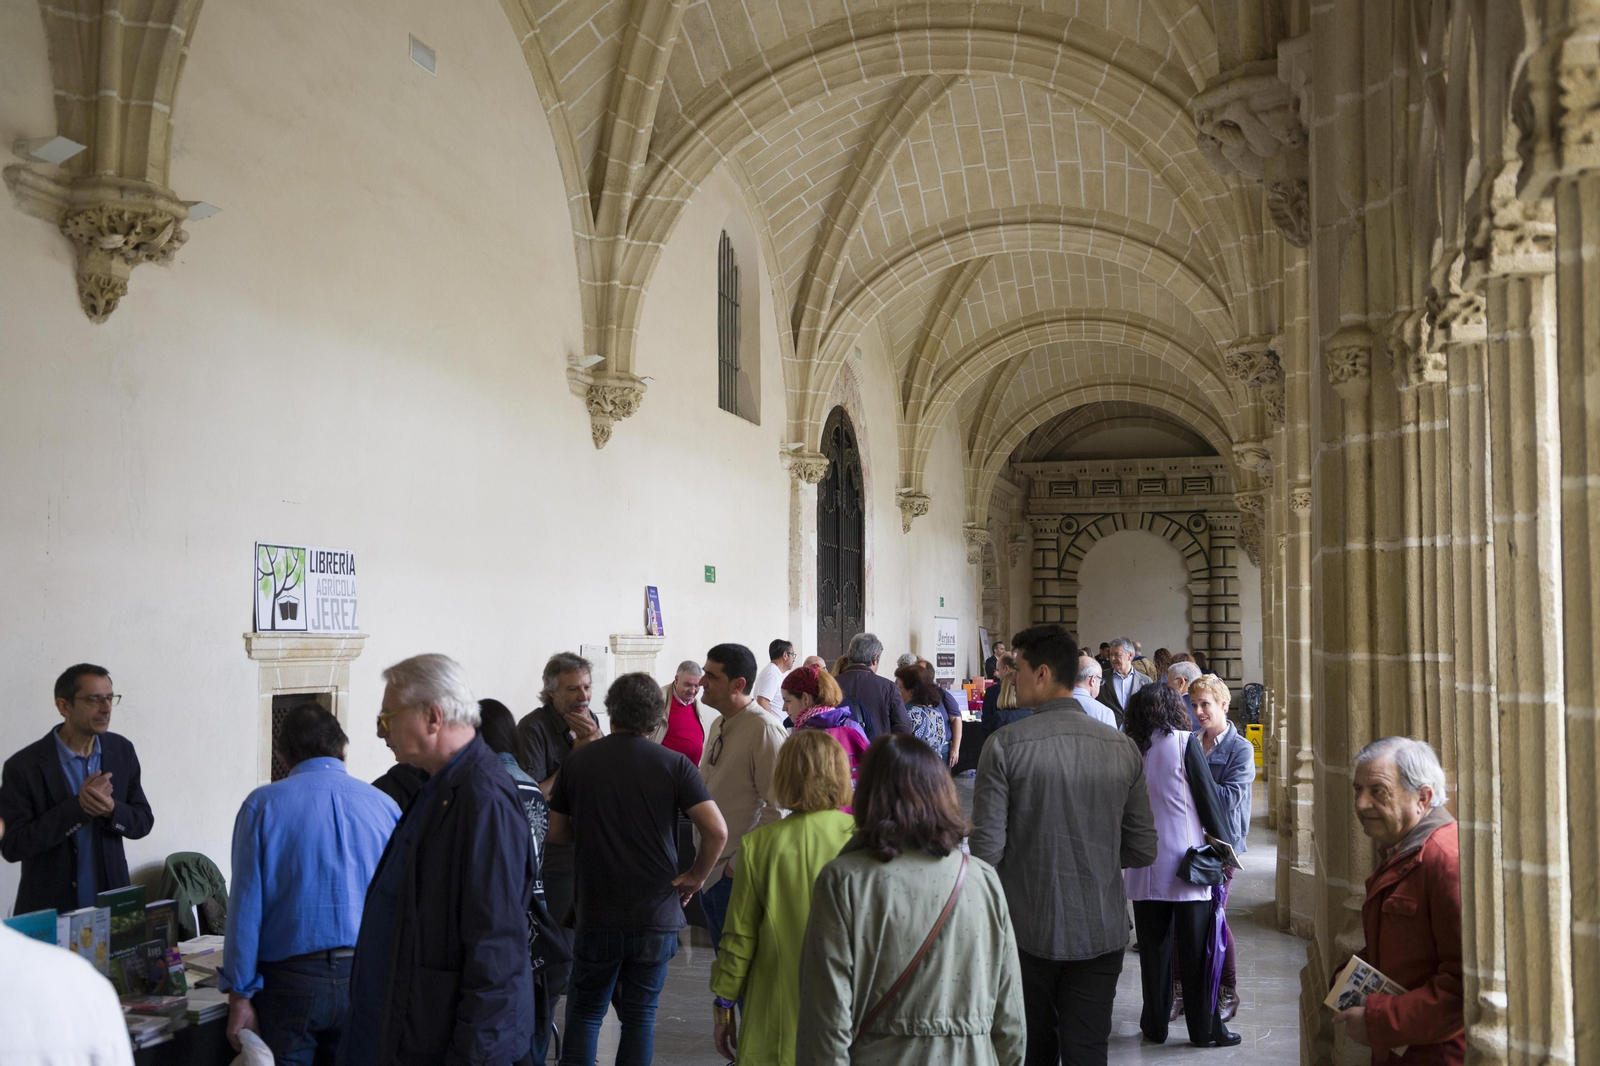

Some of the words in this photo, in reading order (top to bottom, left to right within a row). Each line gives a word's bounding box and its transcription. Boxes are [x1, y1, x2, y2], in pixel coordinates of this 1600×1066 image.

[310, 550, 356, 576] LIBRERÍA
[316, 576, 356, 597] AGRÍCOLA
[311, 597, 359, 631] JEREZ
[147, 946, 162, 958] Aves
